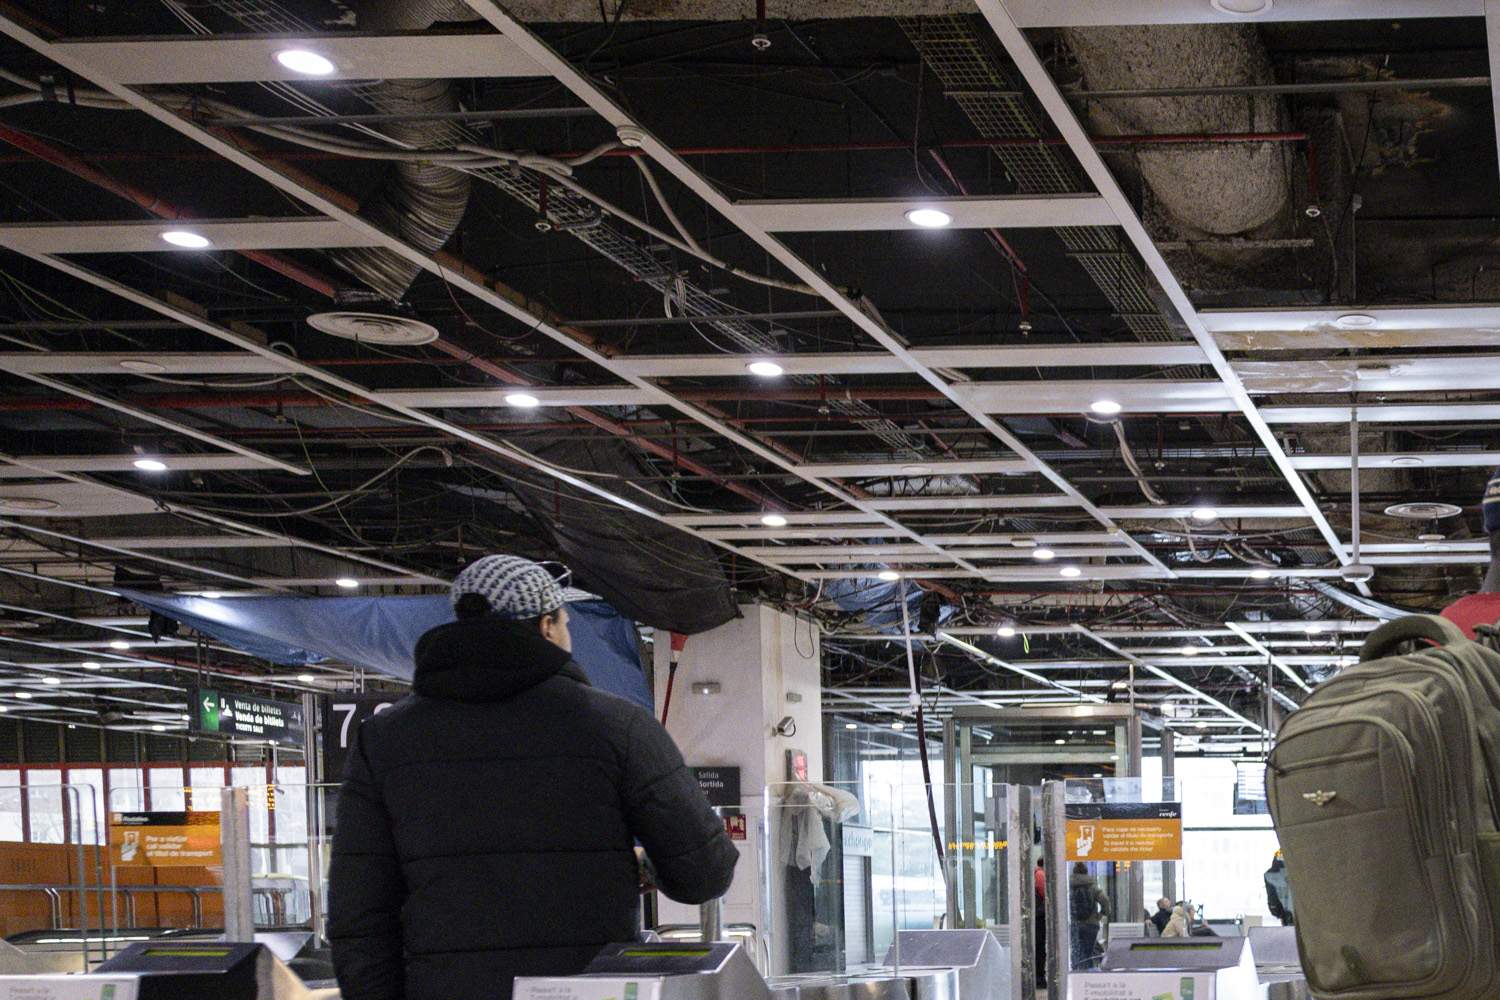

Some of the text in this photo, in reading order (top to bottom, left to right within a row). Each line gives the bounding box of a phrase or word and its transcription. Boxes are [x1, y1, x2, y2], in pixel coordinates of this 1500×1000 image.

[235, 700, 251, 710] Venta
[252, 703, 260, 712] de
[255, 714, 263, 724] de
[698, 771, 719, 779] Salida
